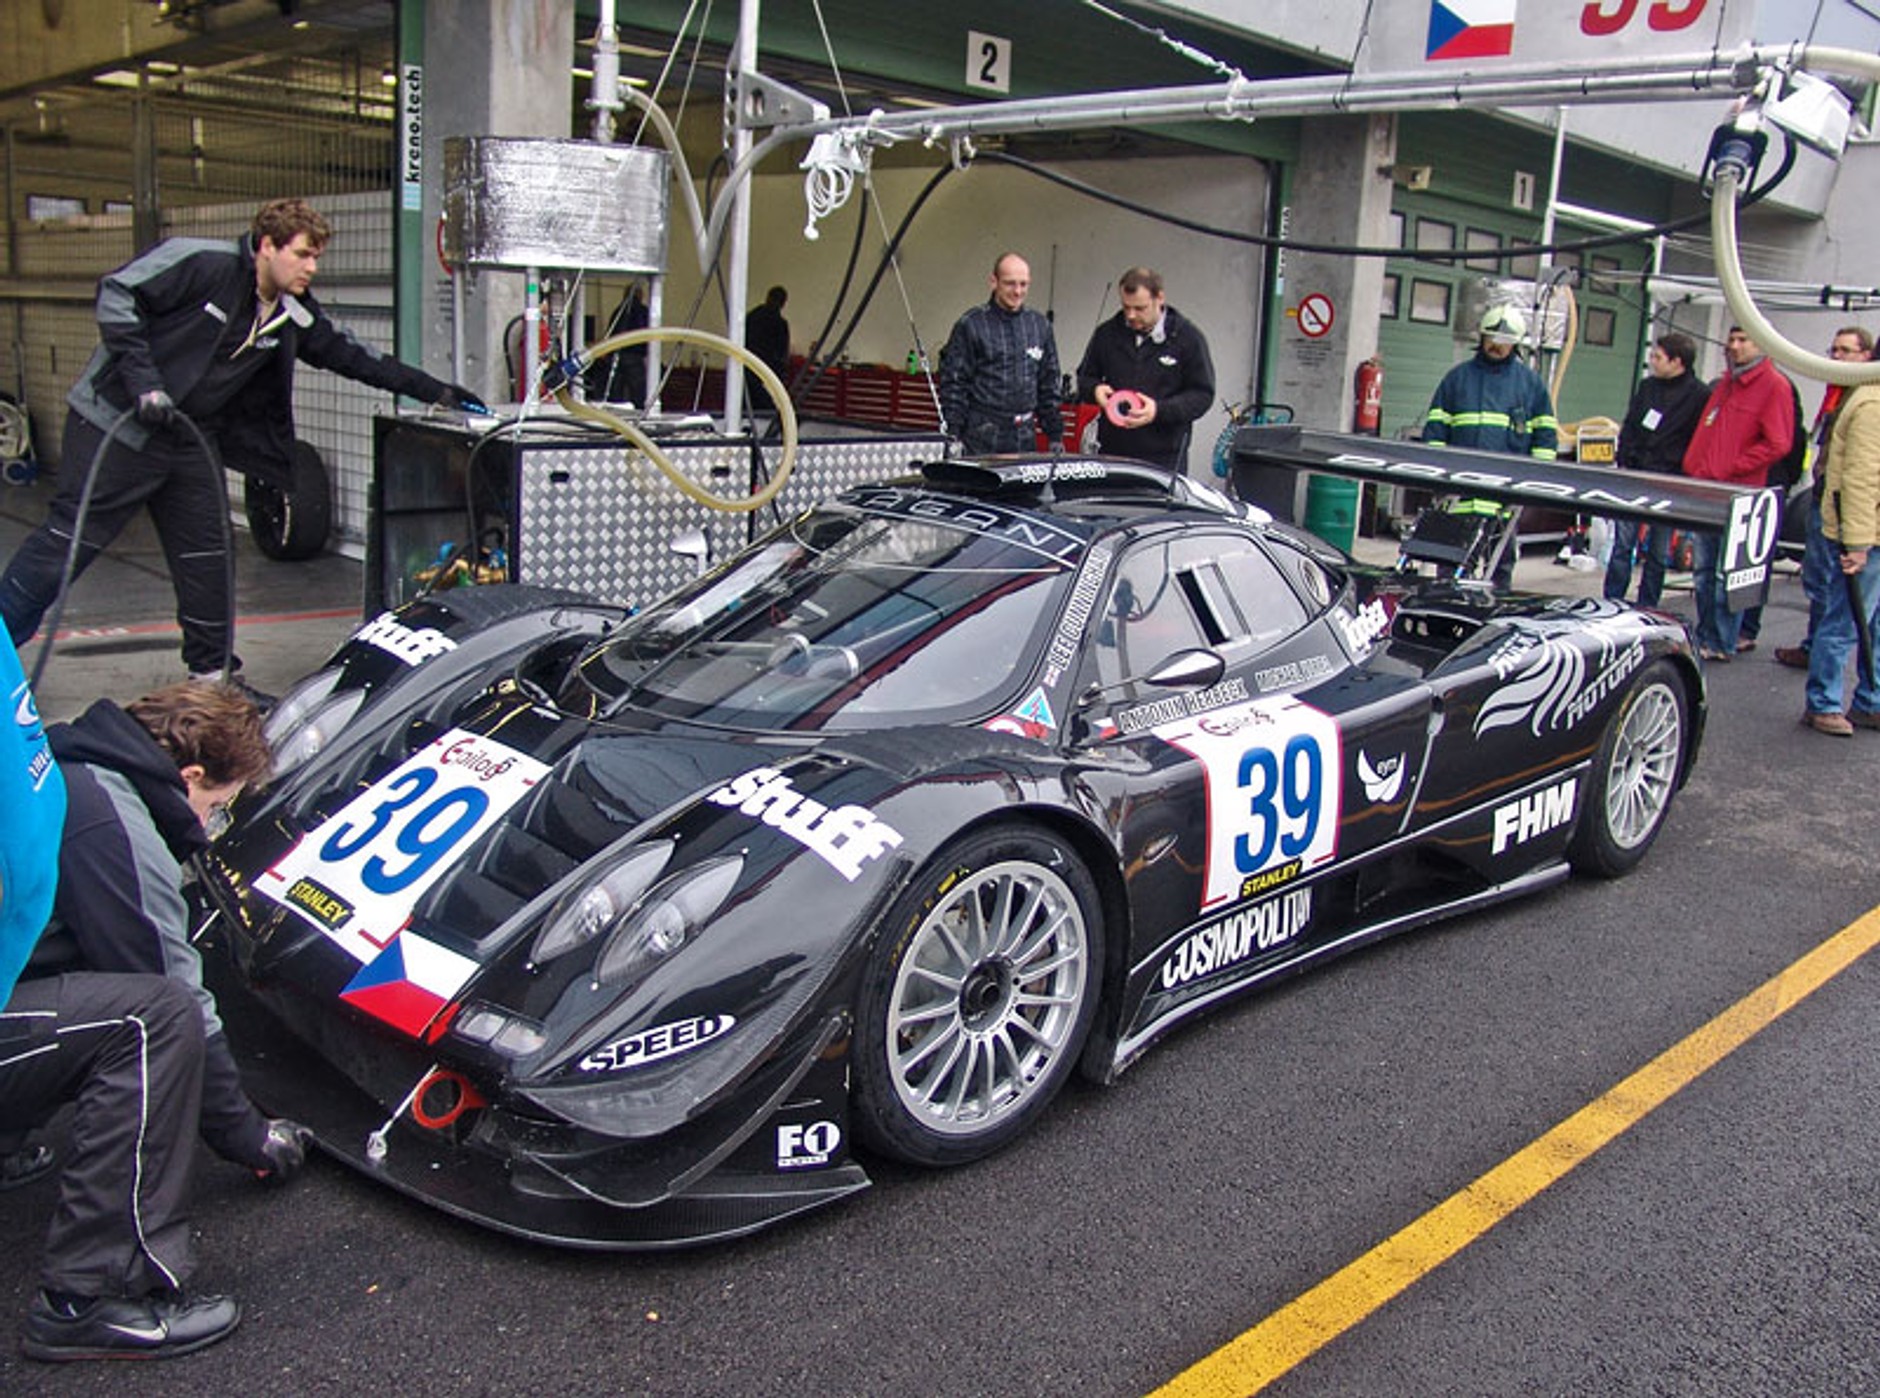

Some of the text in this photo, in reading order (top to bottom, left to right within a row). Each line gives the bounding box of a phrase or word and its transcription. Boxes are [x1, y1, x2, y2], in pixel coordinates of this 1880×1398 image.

[980, 41, 998, 83] 2
[1724, 488, 1779, 571] F1
[319, 766, 491, 896] 39
[1234, 733, 1323, 874] 39
[1492, 778, 1577, 856] FHM
[291, 880, 351, 923] STANLEY
[1241, 861, 1301, 897] STANLEY
[588, 1014, 724, 1071] SPEED
[778, 1121, 841, 1158] F1
